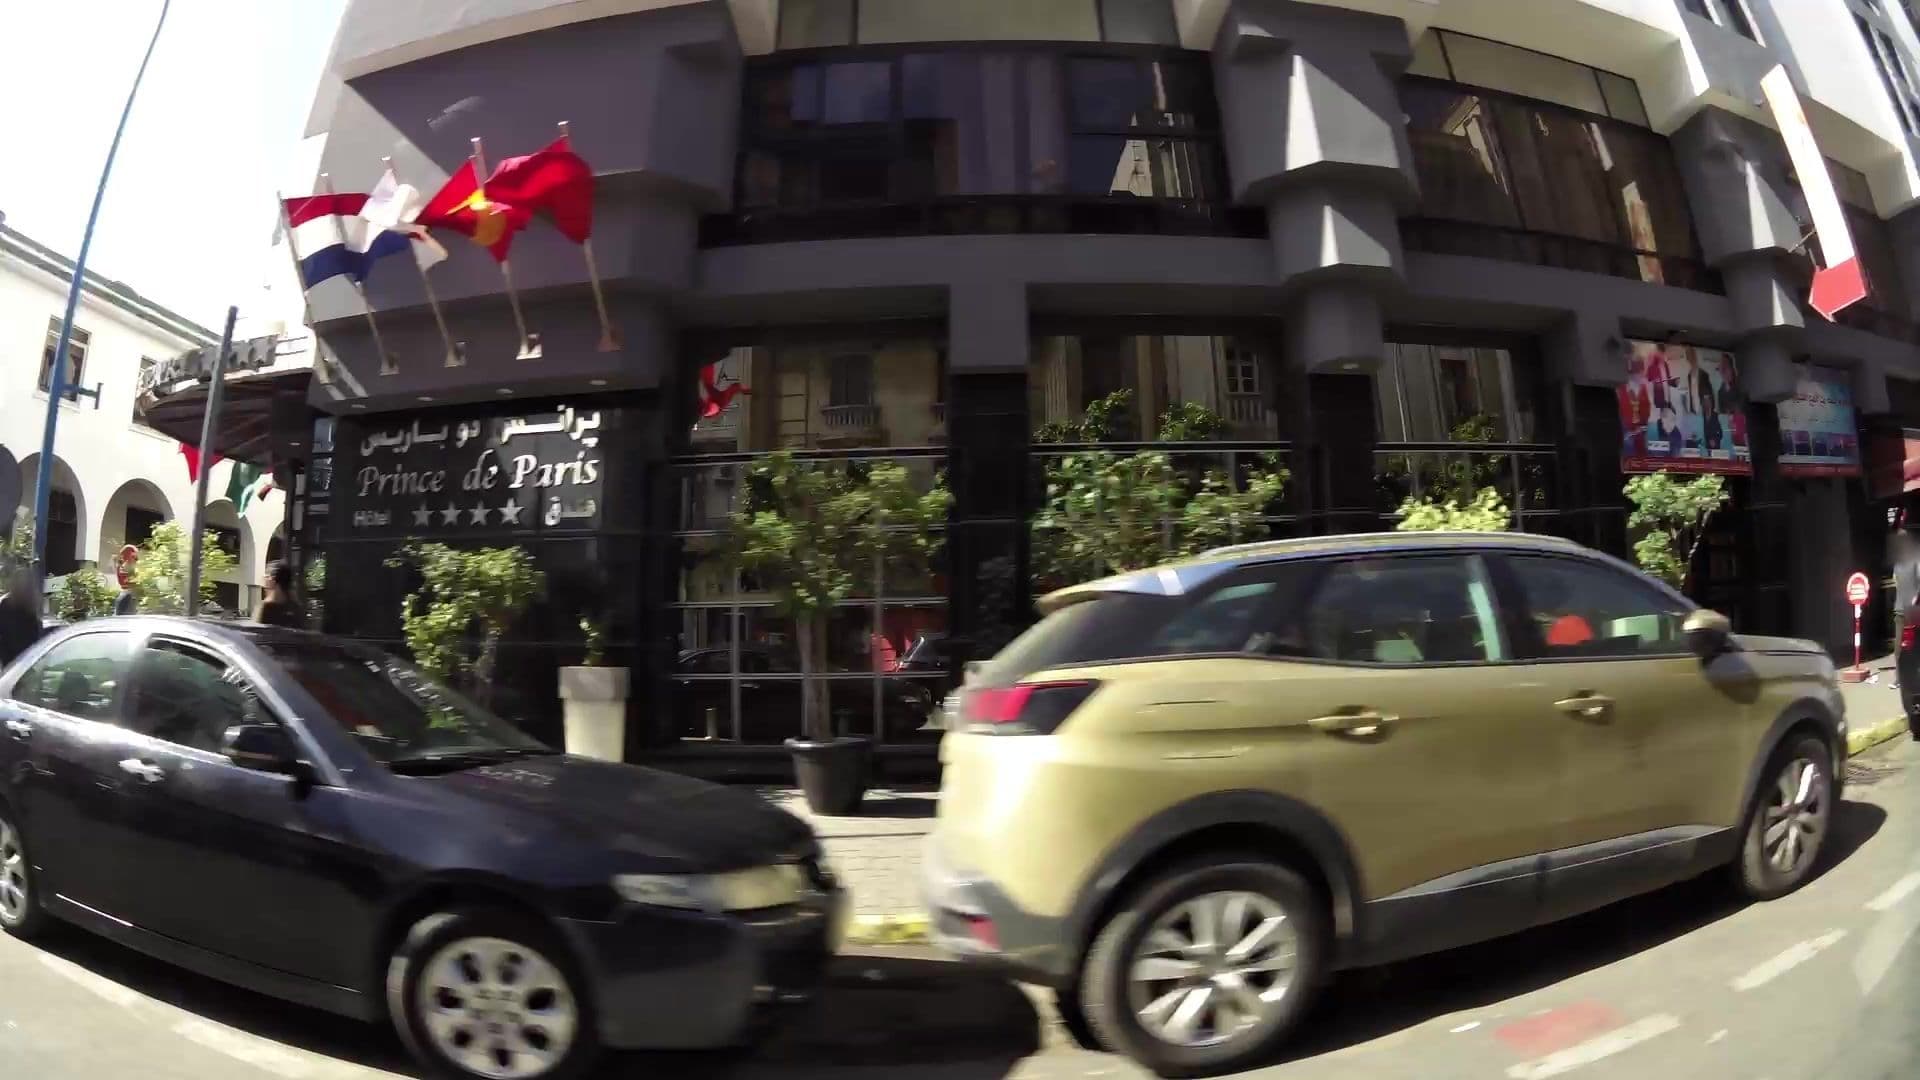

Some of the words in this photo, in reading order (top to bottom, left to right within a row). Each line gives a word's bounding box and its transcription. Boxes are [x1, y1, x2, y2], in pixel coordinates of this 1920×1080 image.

[356, 464, 446, 497] Prince
[463, 449, 500, 492] de
[508, 451, 600, 489] Paris
